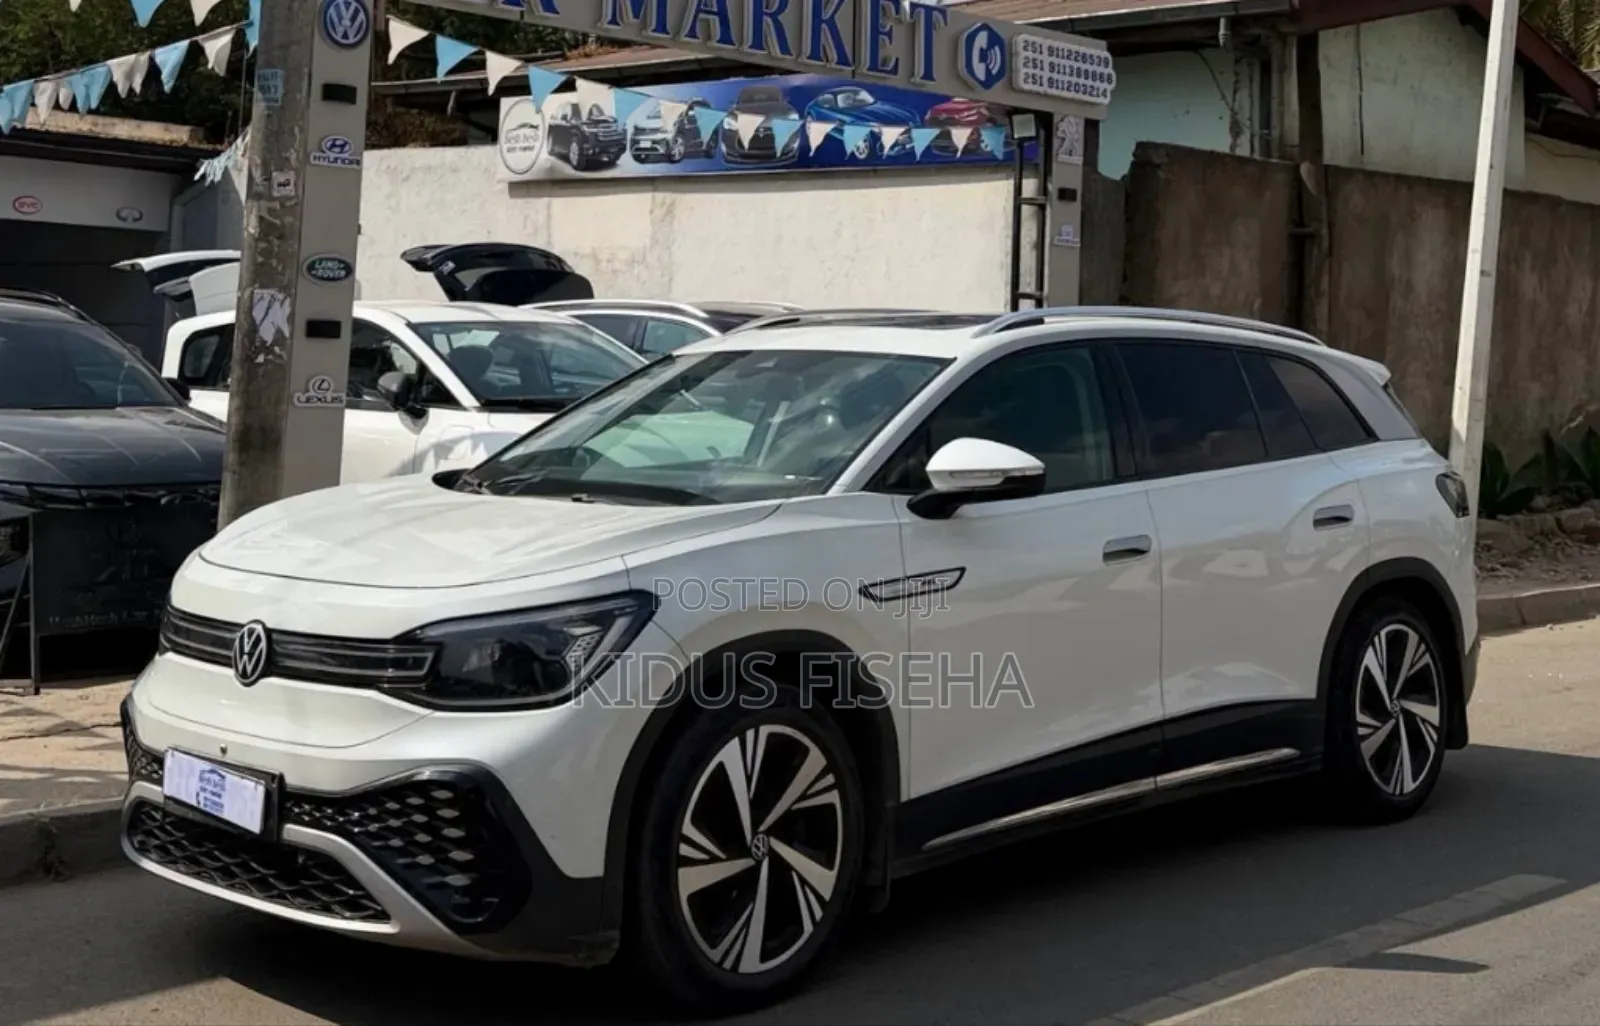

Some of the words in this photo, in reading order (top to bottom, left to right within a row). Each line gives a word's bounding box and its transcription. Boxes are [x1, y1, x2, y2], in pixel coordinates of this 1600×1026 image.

[1022, 40, 1043, 55] 251
[1022, 56, 1044, 71] 251
[1023, 72, 1044, 87] 251
[297, 395, 344, 404] LEXUS
